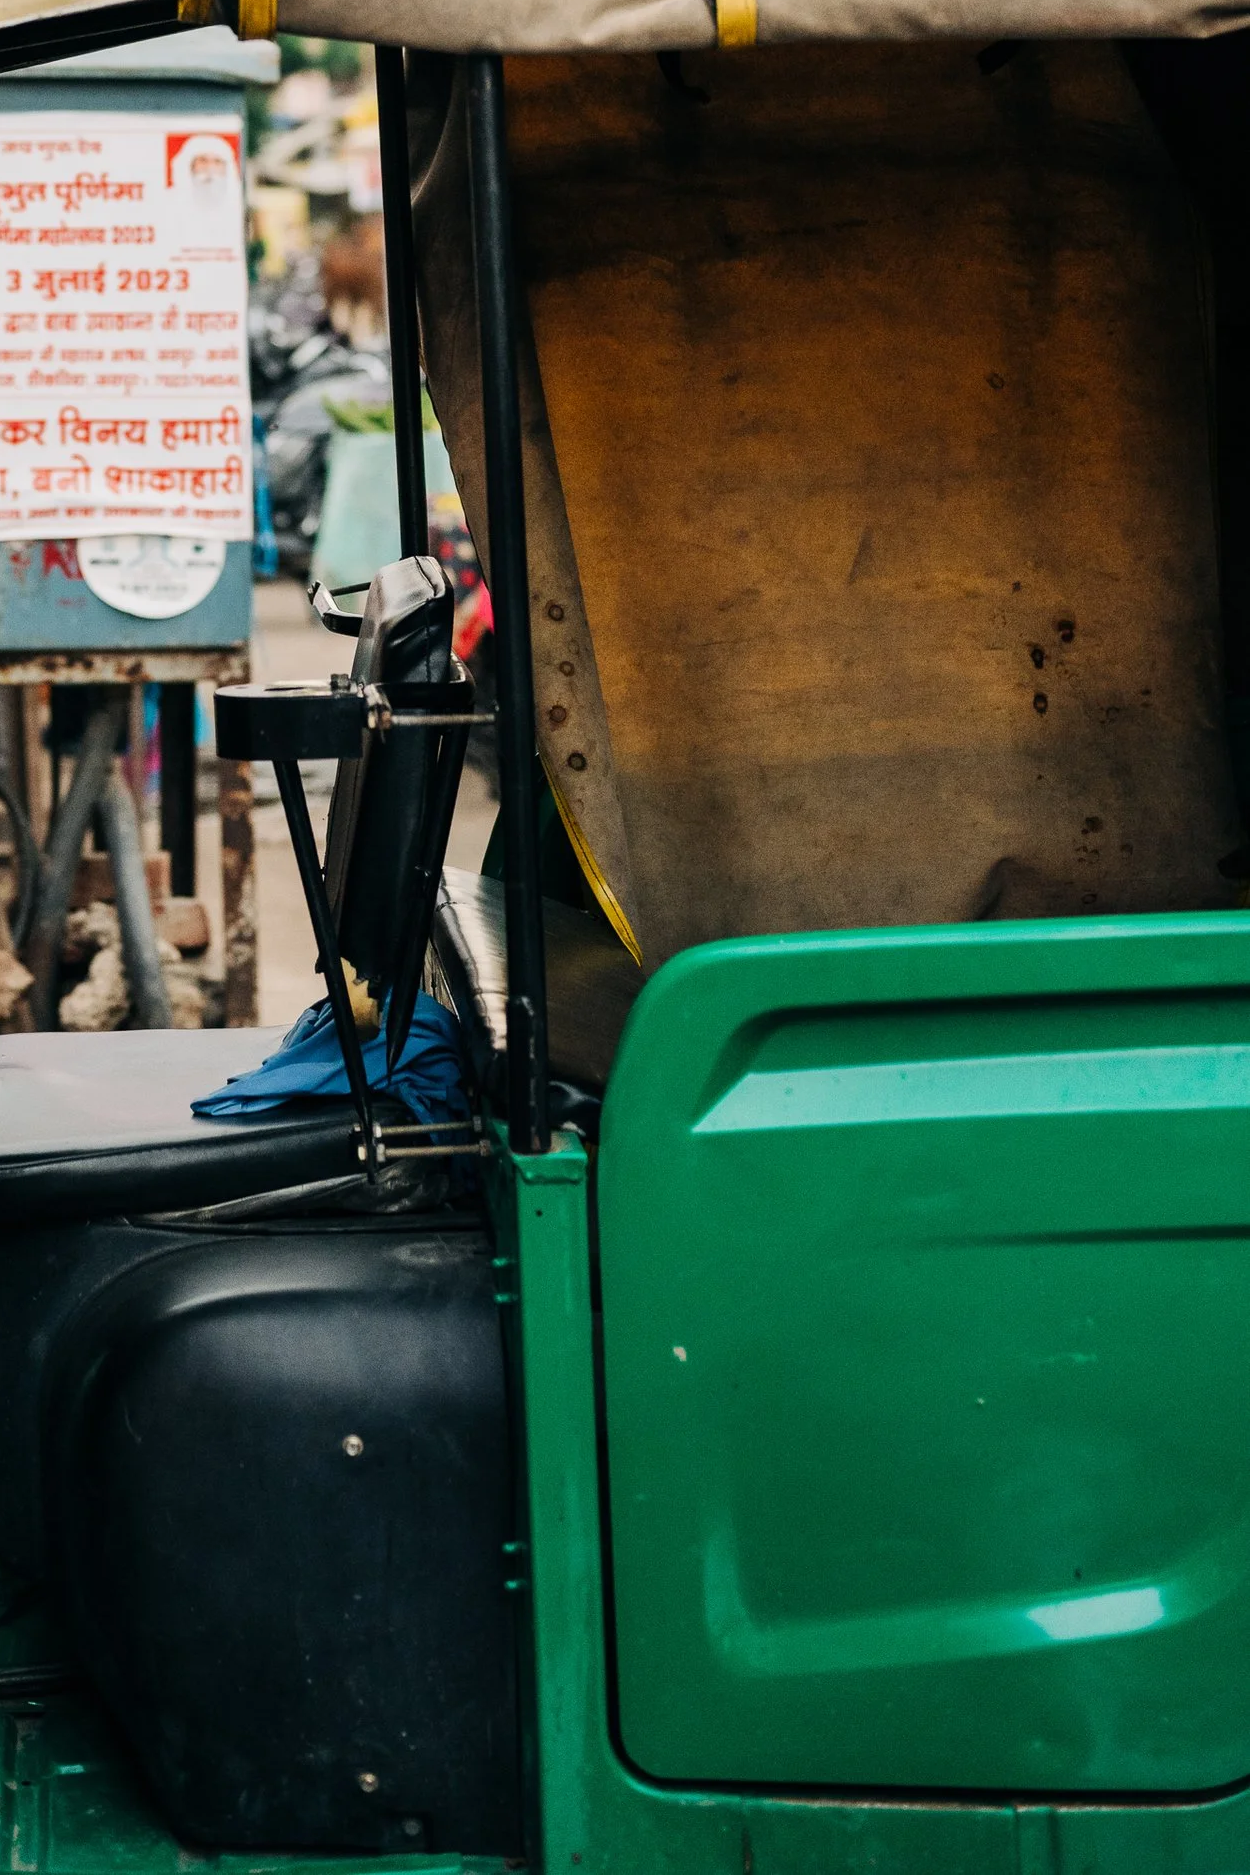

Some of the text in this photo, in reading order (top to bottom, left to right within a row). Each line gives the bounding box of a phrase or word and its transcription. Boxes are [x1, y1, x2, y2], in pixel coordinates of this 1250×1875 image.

[53, 172, 145, 213] पूर्णिमा
[7, 269, 22, 293] 3
[33, 263, 107, 301] जुलाई
[117, 269, 190, 293] 2023
[57, 405, 149, 445] विनय
[159, 405, 242, 452] हमारी
[31, 453, 93, 493] बनो
[104, 454, 243, 498] शाकाहारी
